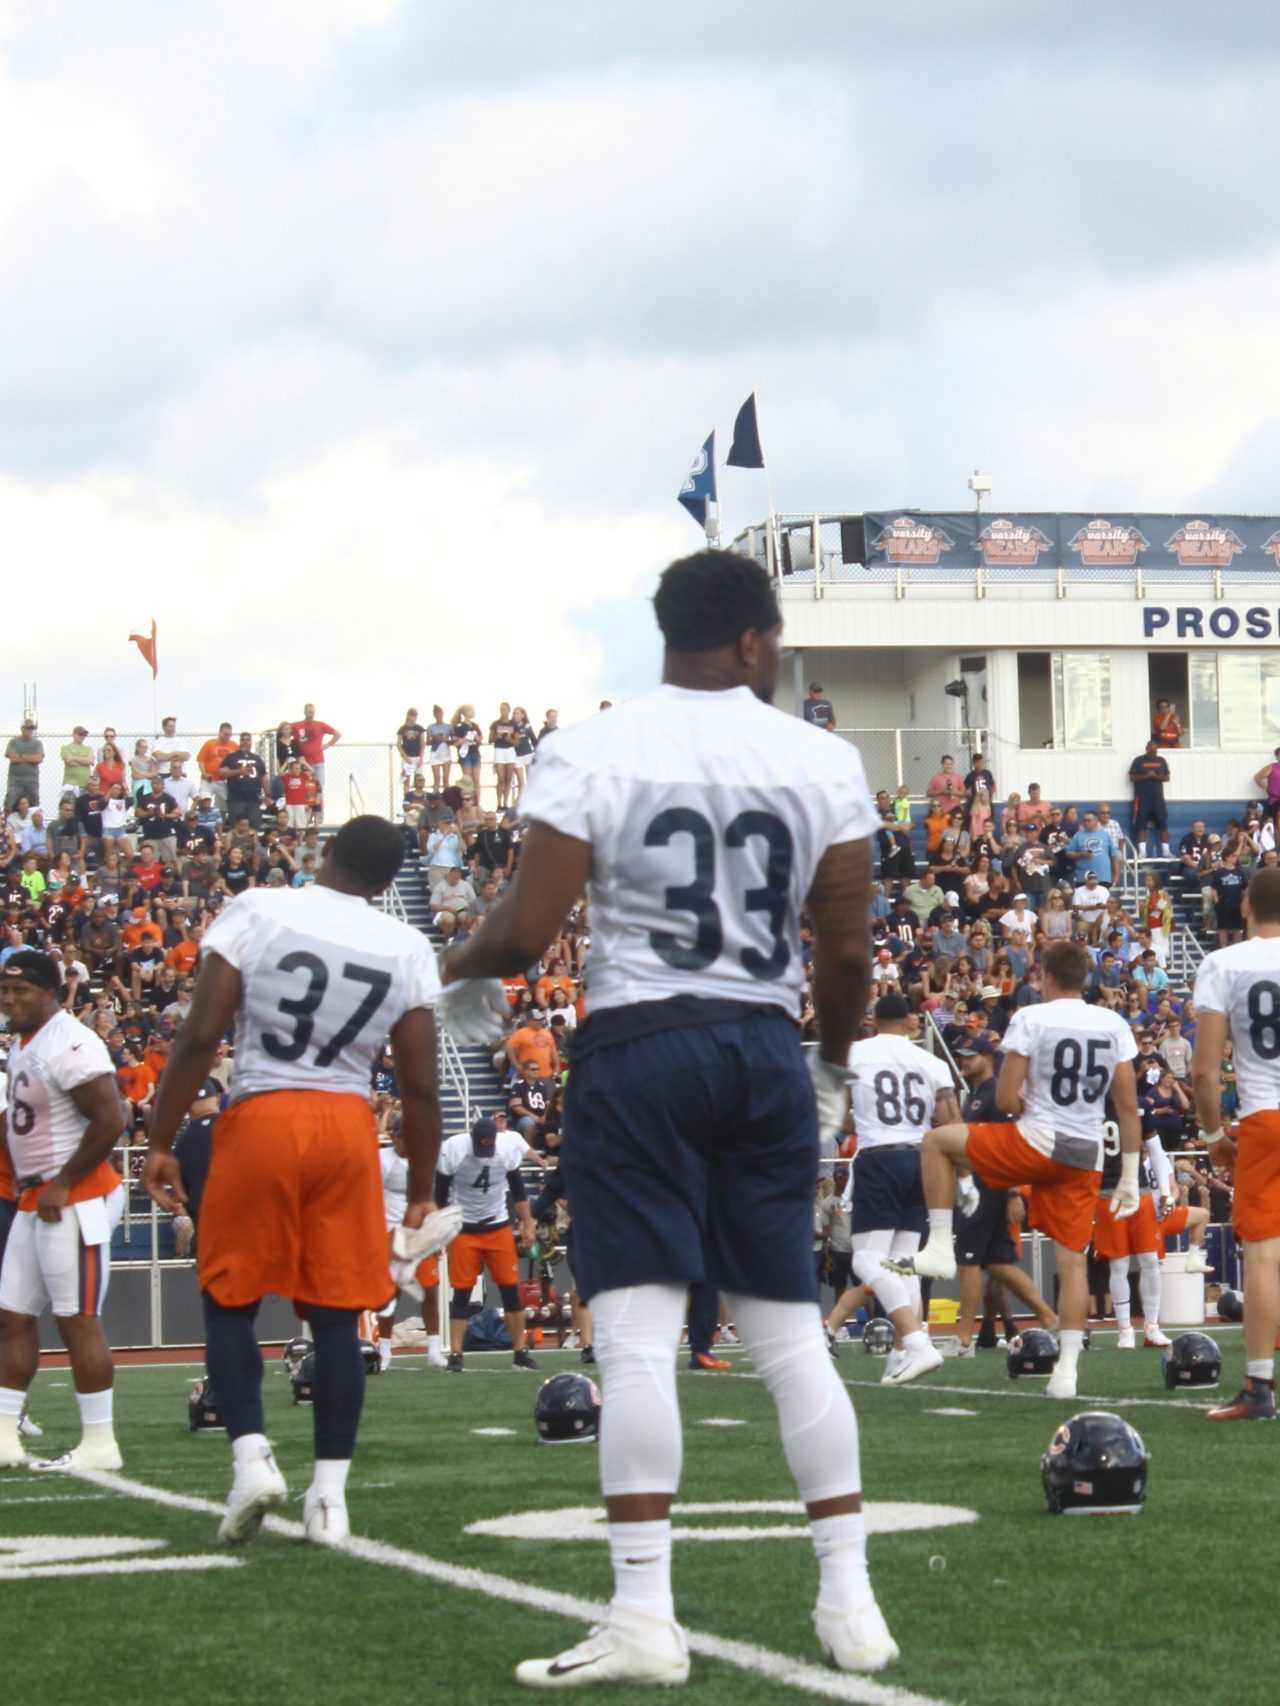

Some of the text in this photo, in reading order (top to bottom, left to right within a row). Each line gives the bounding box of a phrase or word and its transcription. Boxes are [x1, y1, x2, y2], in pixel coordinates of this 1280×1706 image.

[893, 529, 931, 541] varsity
[992, 530, 1030, 542] varsity
[1087, 530, 1129, 542] varsity
[1184, 531, 1226, 543] varsity
[642, 807, 795, 980] 33
[898, 924, 914, 942] 10
[261, 950, 393, 1068] 37
[1050, 1037, 1112, 1106] 85
[10, 1070, 36, 1137] 6
[873, 1069, 927, 1127] 86
[470, 1165, 492, 1194] 4
